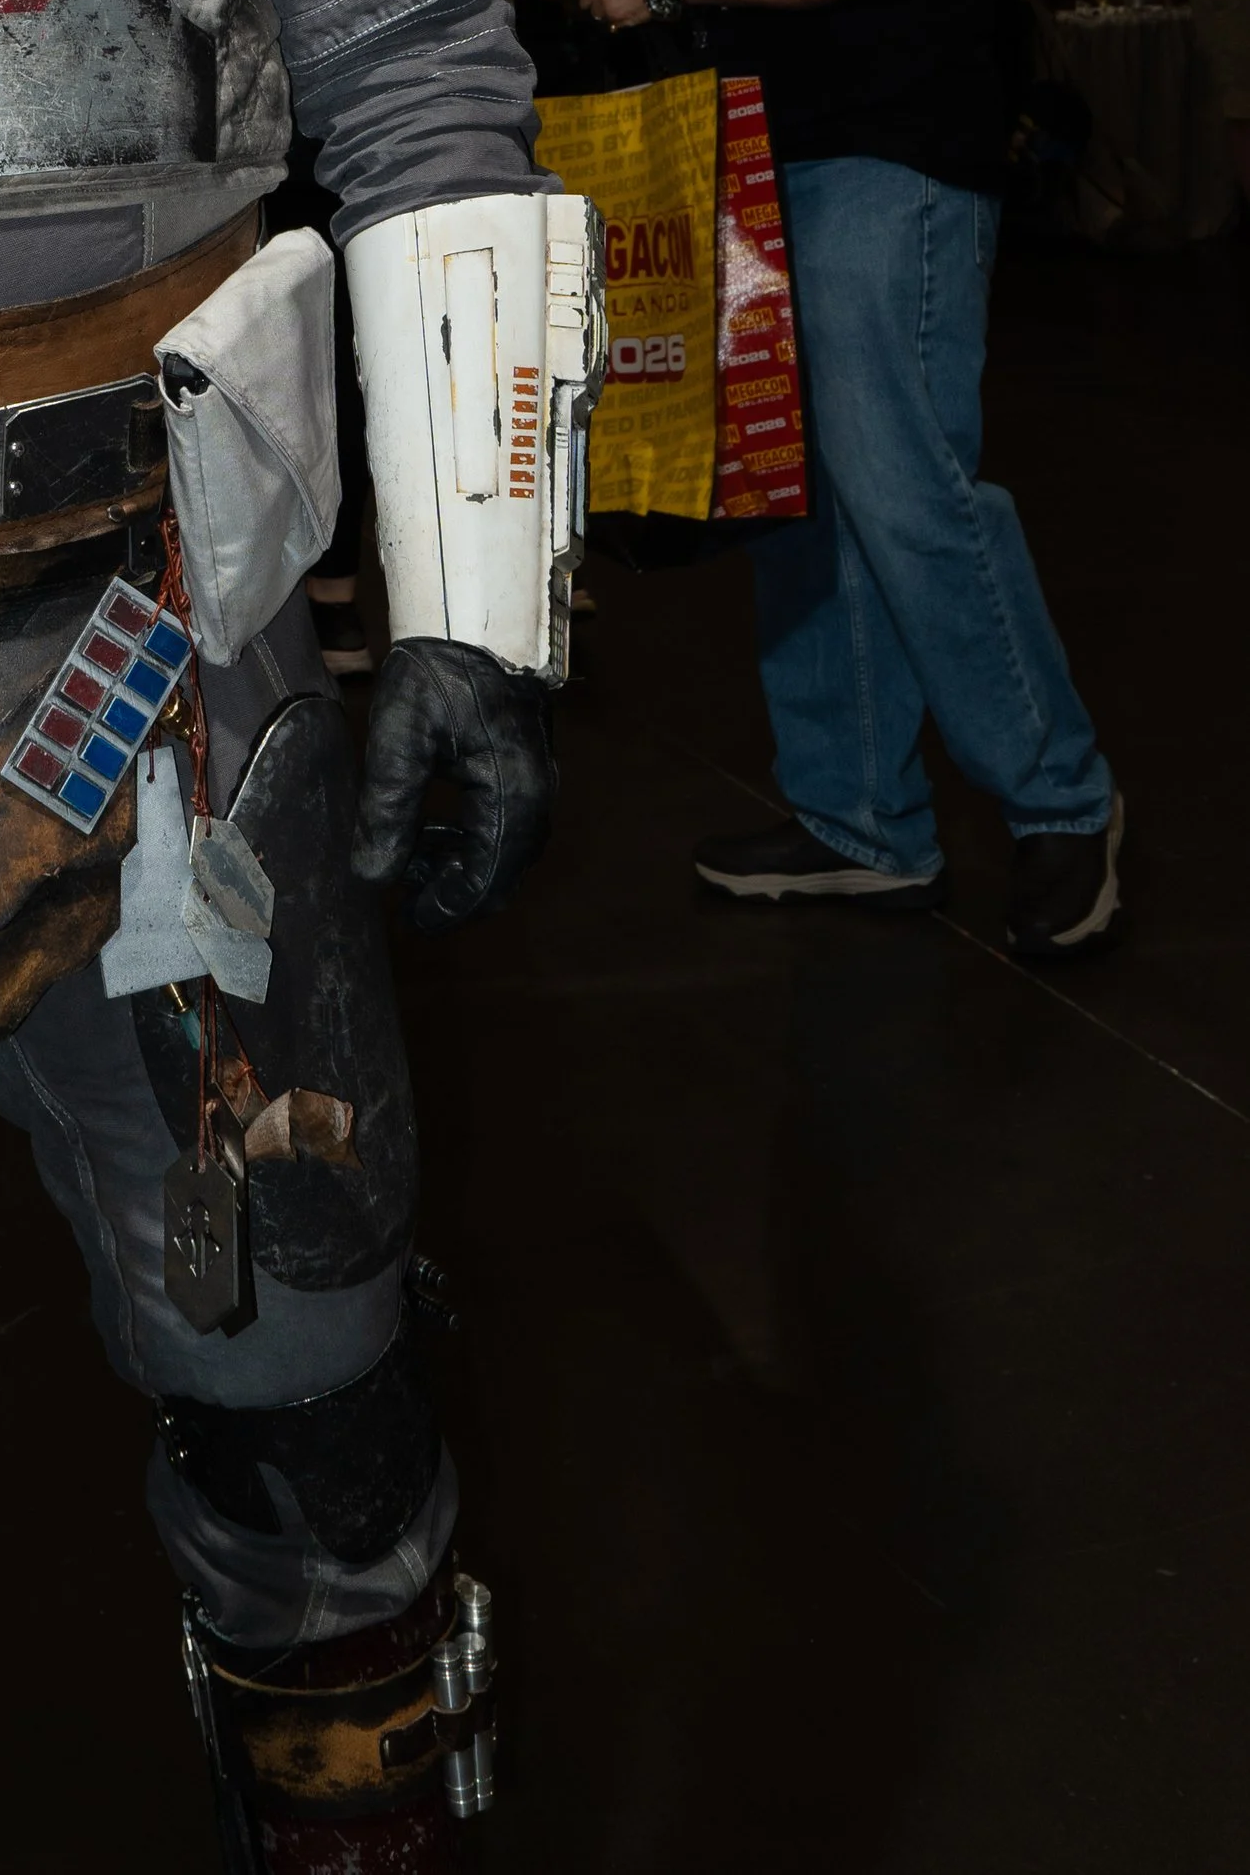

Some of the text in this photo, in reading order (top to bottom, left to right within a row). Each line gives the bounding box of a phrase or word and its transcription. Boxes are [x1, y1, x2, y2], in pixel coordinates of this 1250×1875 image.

[727, 101, 765, 120] 2026
[602, 129, 633, 153] BY
[726, 135, 770, 161] MEGAC
[745, 169, 775, 185] 202
[743, 204, 780, 225] MEGA
[606, 213, 694, 281] GACON
[763, 237, 785, 252] 20
[611, 292, 690, 316] LANDO
[607, 333, 687, 377] 026
[728, 349, 771, 367] 2026
[727, 375, 790, 406] MEGACON
[744, 416, 787, 436] 2026
[766, 484, 802, 502] 2026
